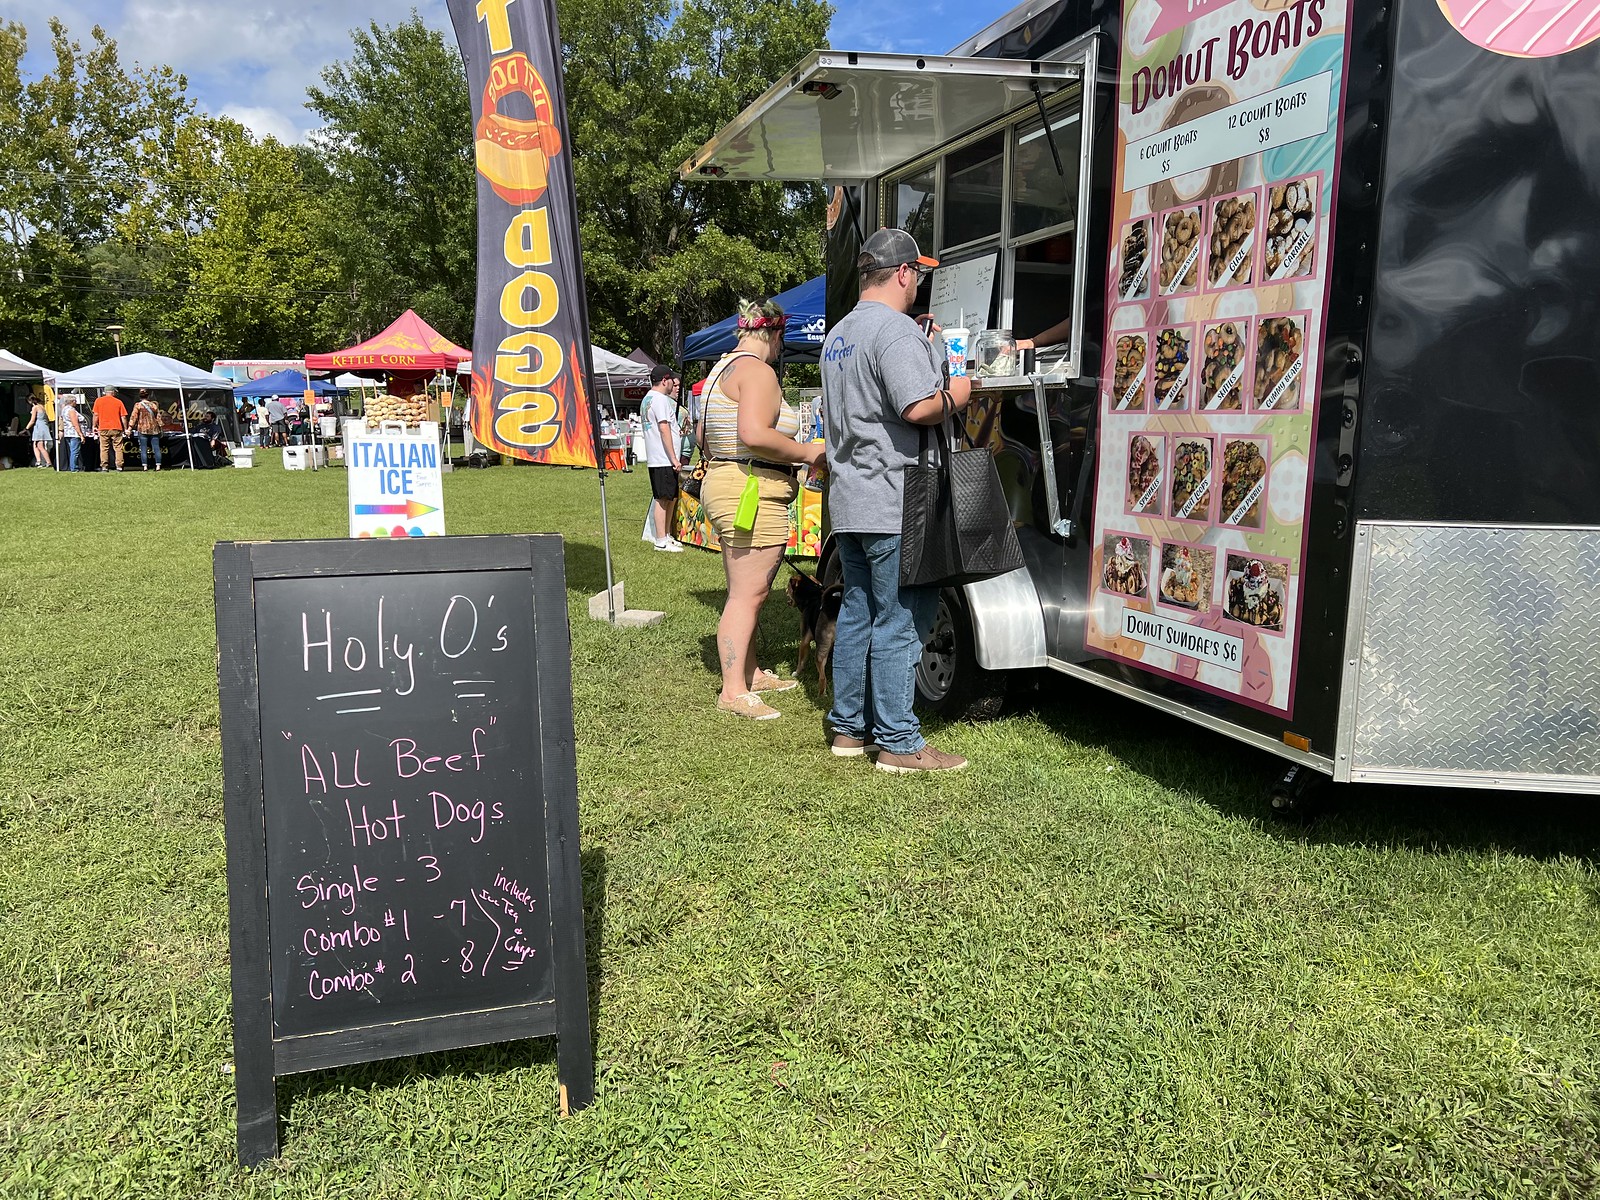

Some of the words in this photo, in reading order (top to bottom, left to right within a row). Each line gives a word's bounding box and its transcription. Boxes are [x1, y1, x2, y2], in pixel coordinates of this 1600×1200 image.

[1131, 37, 1220, 115] DONUT
[1227, 0, 1326, 80] BOATS
[1227, 115, 1237, 130] 12
[1240, 103, 1273, 126] COUNT
[1275, 92, 1308, 118] BOATS
[1139, 147, 1145, 160] 6
[1145, 138, 1173, 159] COUNT
[1173, 130, 1198, 151] BOATS
[1258, 127, 1270, 144] $8
[1161, 158, 1171, 174] $5
[1229, 249, 1246, 272] GLAZE
[1283, 233, 1310, 268] CARAMEL
[1133, 269, 1144, 288] OREO
[332, 355, 375, 365] KETTLE
[381, 354, 416, 366] CORN
[1265, 381, 1286, 408] GUMMY
[1285, 359, 1302, 384] BEARS
[353, 442, 437, 468] ITALIAN
[380, 469, 413, 495] ICE
[302, 596, 415, 696] Holy
[440, 595, 508, 659] O's
[1126, 615, 1163, 639] DONUT
[1166, 626, 1220, 656] SUNDAE'S
[1222, 640, 1238, 662] $6
[345, 799, 406, 847] Hot
[427, 791, 505, 843] Dogs
[297, 865, 378, 915] Single
[417, 855, 441, 882] 3
[493, 866, 536, 913] includes
[304, 920, 381, 955] Combo
[309, 968, 375, 1000] Combo
